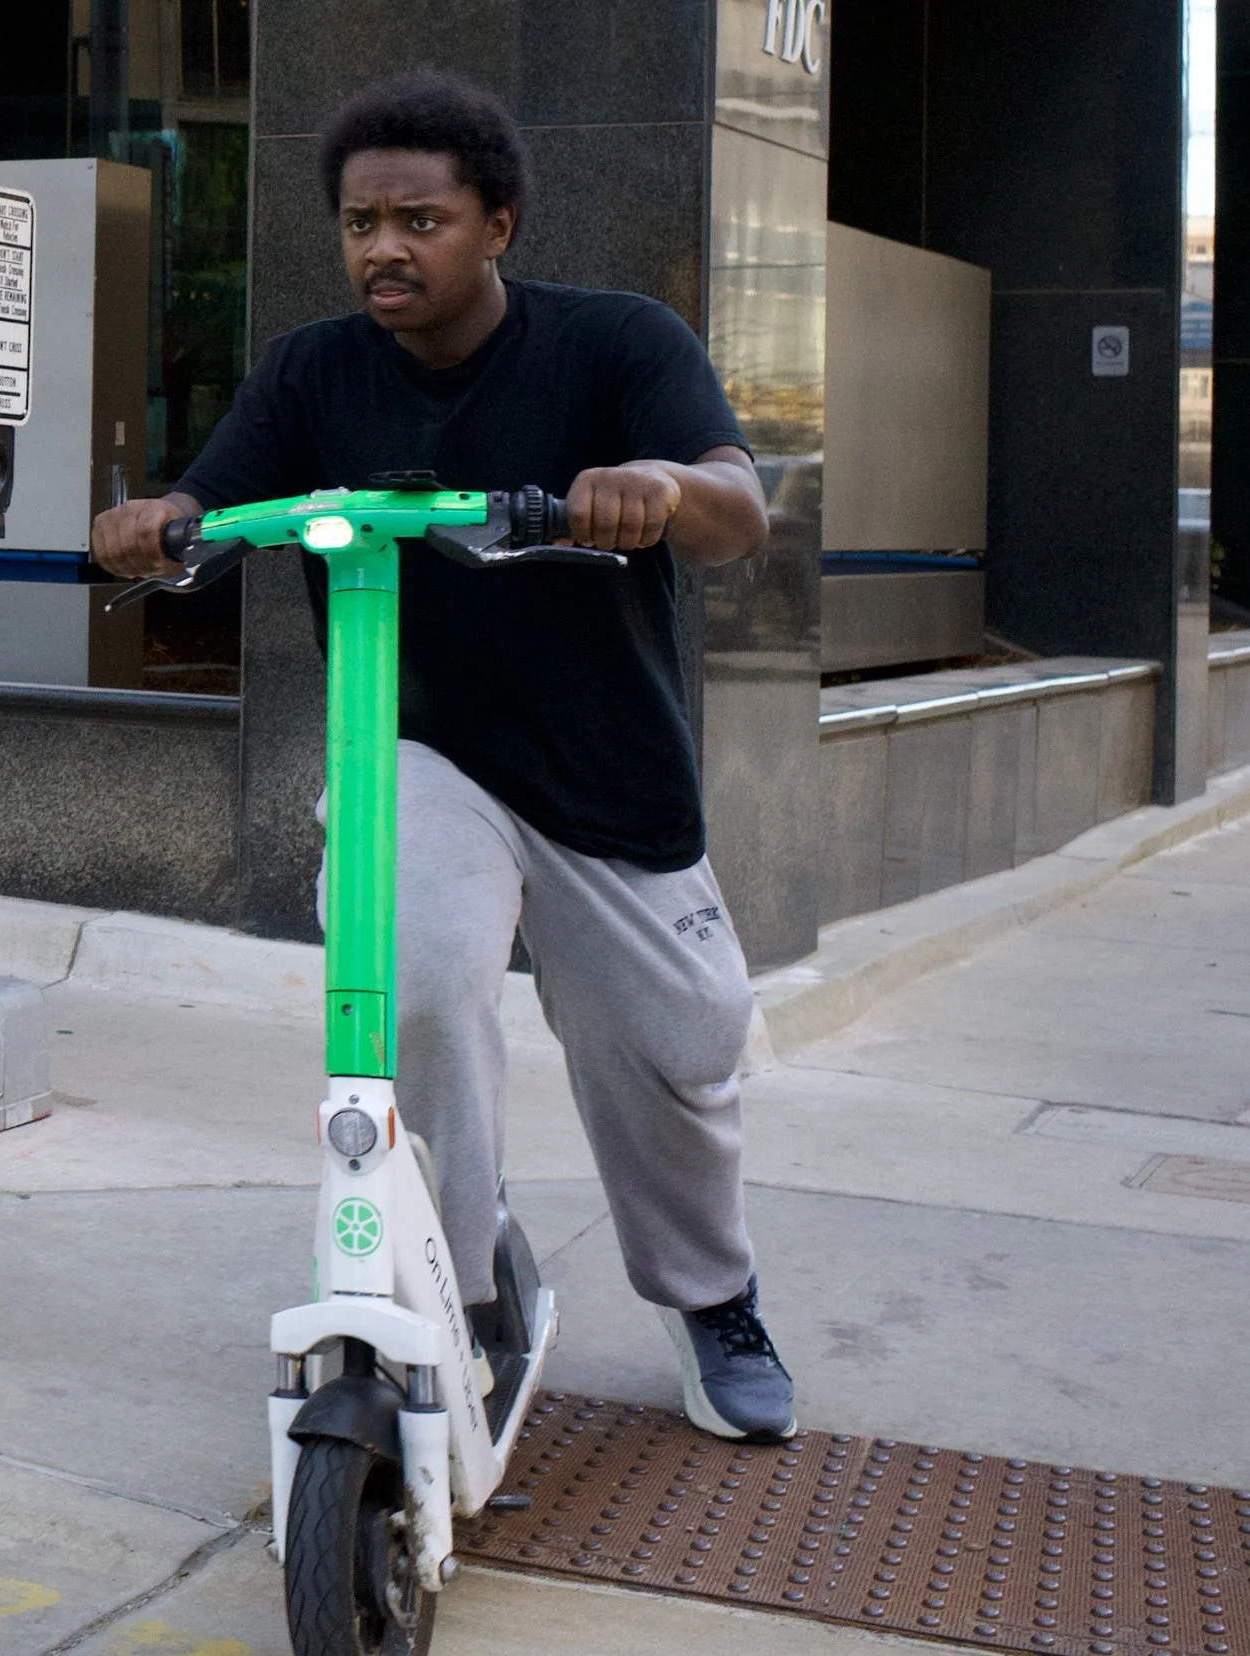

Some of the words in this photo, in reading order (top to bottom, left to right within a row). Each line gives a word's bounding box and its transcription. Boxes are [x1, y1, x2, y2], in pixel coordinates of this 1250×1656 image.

[8, 205, 28, 219] CROSSING
[4, 290, 27, 304] REMAINING
[9, 342, 22, 353] CROSS
[425, 1237, 442, 1284] On
[439, 1277, 460, 1348] Lime
